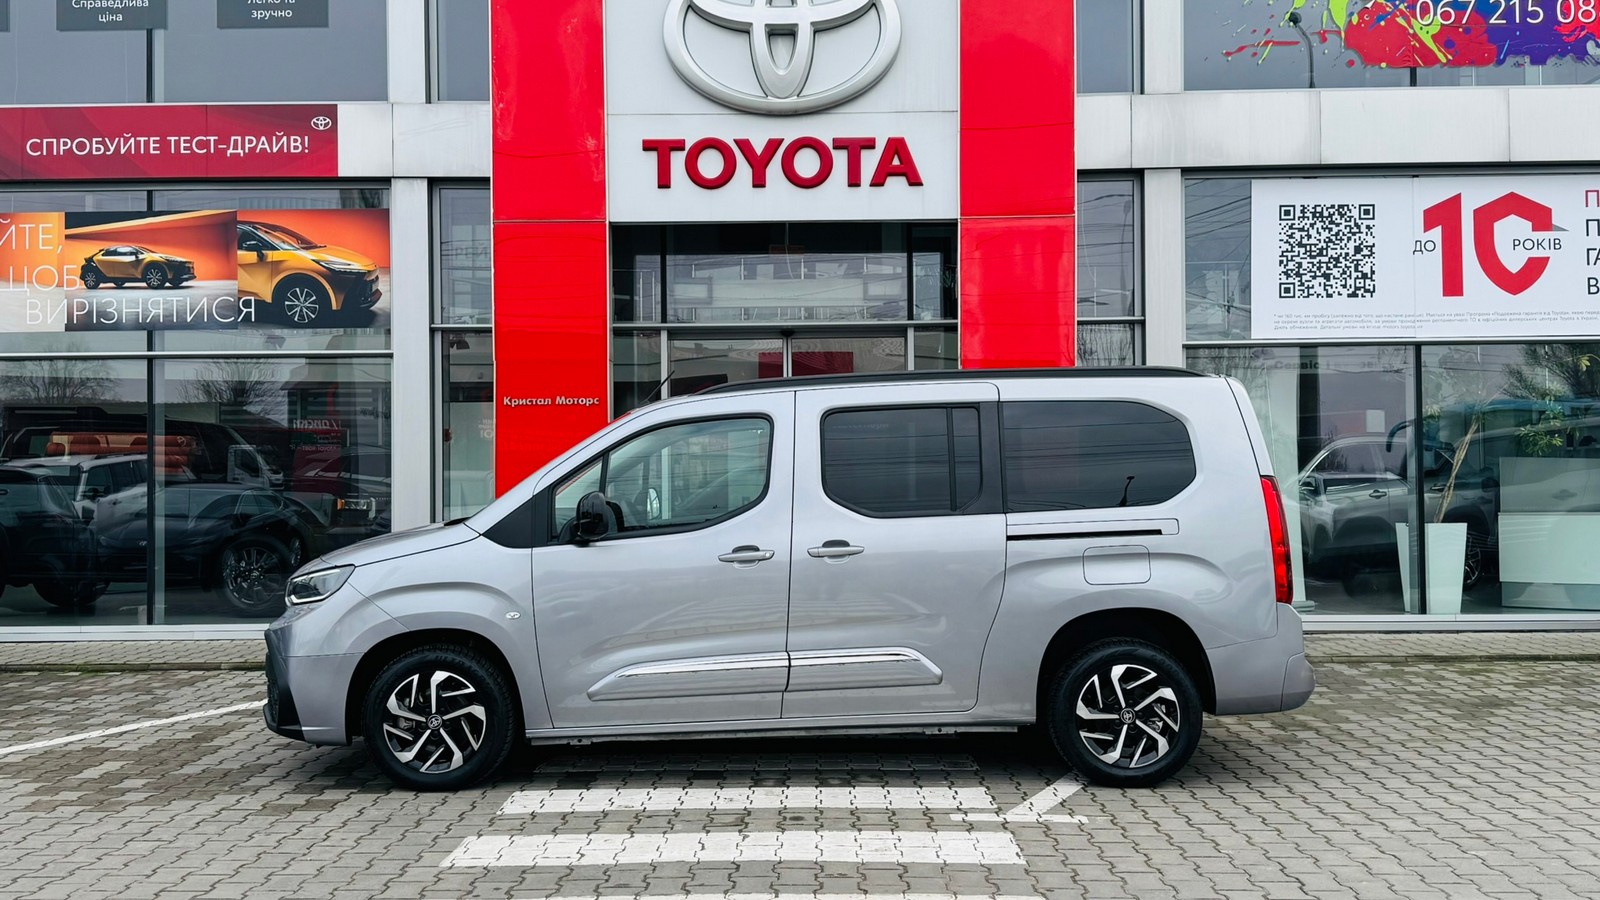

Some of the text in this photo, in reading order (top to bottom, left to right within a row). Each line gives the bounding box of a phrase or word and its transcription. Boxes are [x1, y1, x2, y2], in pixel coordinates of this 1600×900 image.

[98, 12, 123, 23] ціна
[251, 9, 293, 20] зручно
[1416, 0, 1597, 25] 067 215 08
[25, 131, 309, 157] СПРОБУЙТЕ ТЕСТ-ДРАЙВ!
[642, 136, 924, 189] TOYOTA
[1412, 240, 1437, 255] ДО
[1512, 238, 1562, 251] РОКІВ
[26, 296, 256, 325] ВИРІЗНЯТИСЯ
[503, 395, 600, 408] Кристал Моторс
